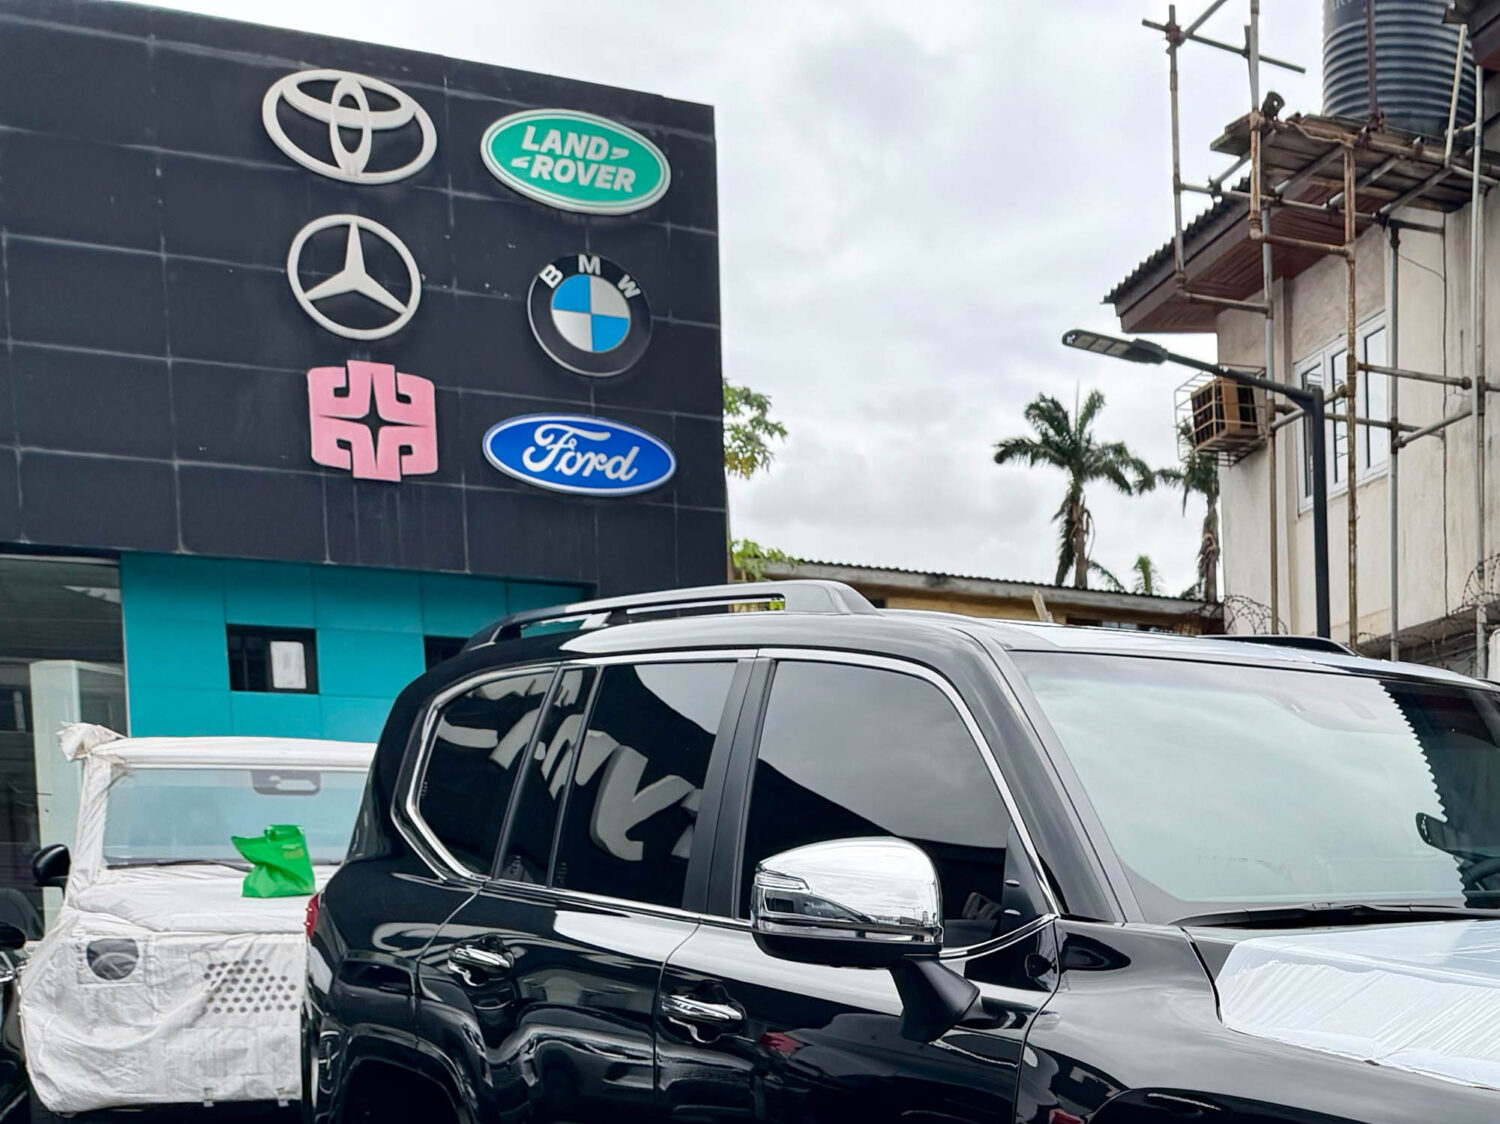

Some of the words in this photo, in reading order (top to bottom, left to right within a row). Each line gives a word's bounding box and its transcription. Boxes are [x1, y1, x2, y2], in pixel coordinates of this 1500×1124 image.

[530, 159, 637, 193] ROVER
[538, 253, 642, 300] BMW
[522, 422, 640, 482] Ford
